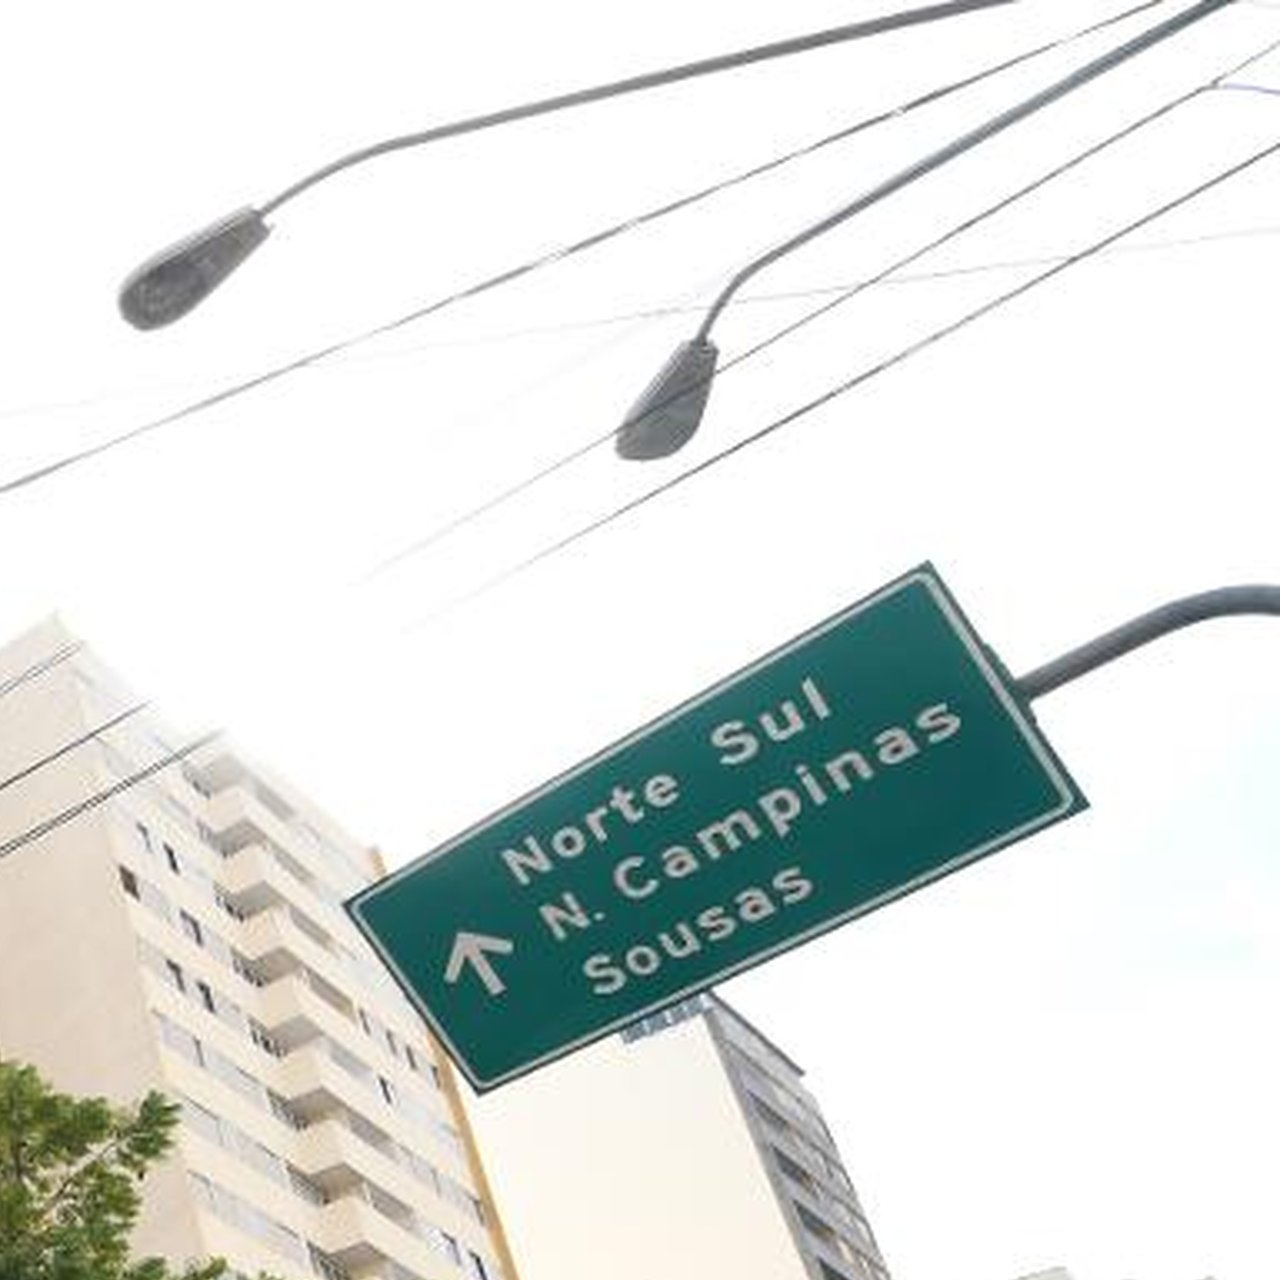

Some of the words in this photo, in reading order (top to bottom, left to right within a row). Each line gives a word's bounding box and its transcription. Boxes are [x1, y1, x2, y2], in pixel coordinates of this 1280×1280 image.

[501, 775, 679, 885] Norte
[711, 677, 830, 765] Sul
[539, 892, 607, 941] N.
[614, 703, 961, 898] Campinas
[583, 867, 812, 994] Sousas
